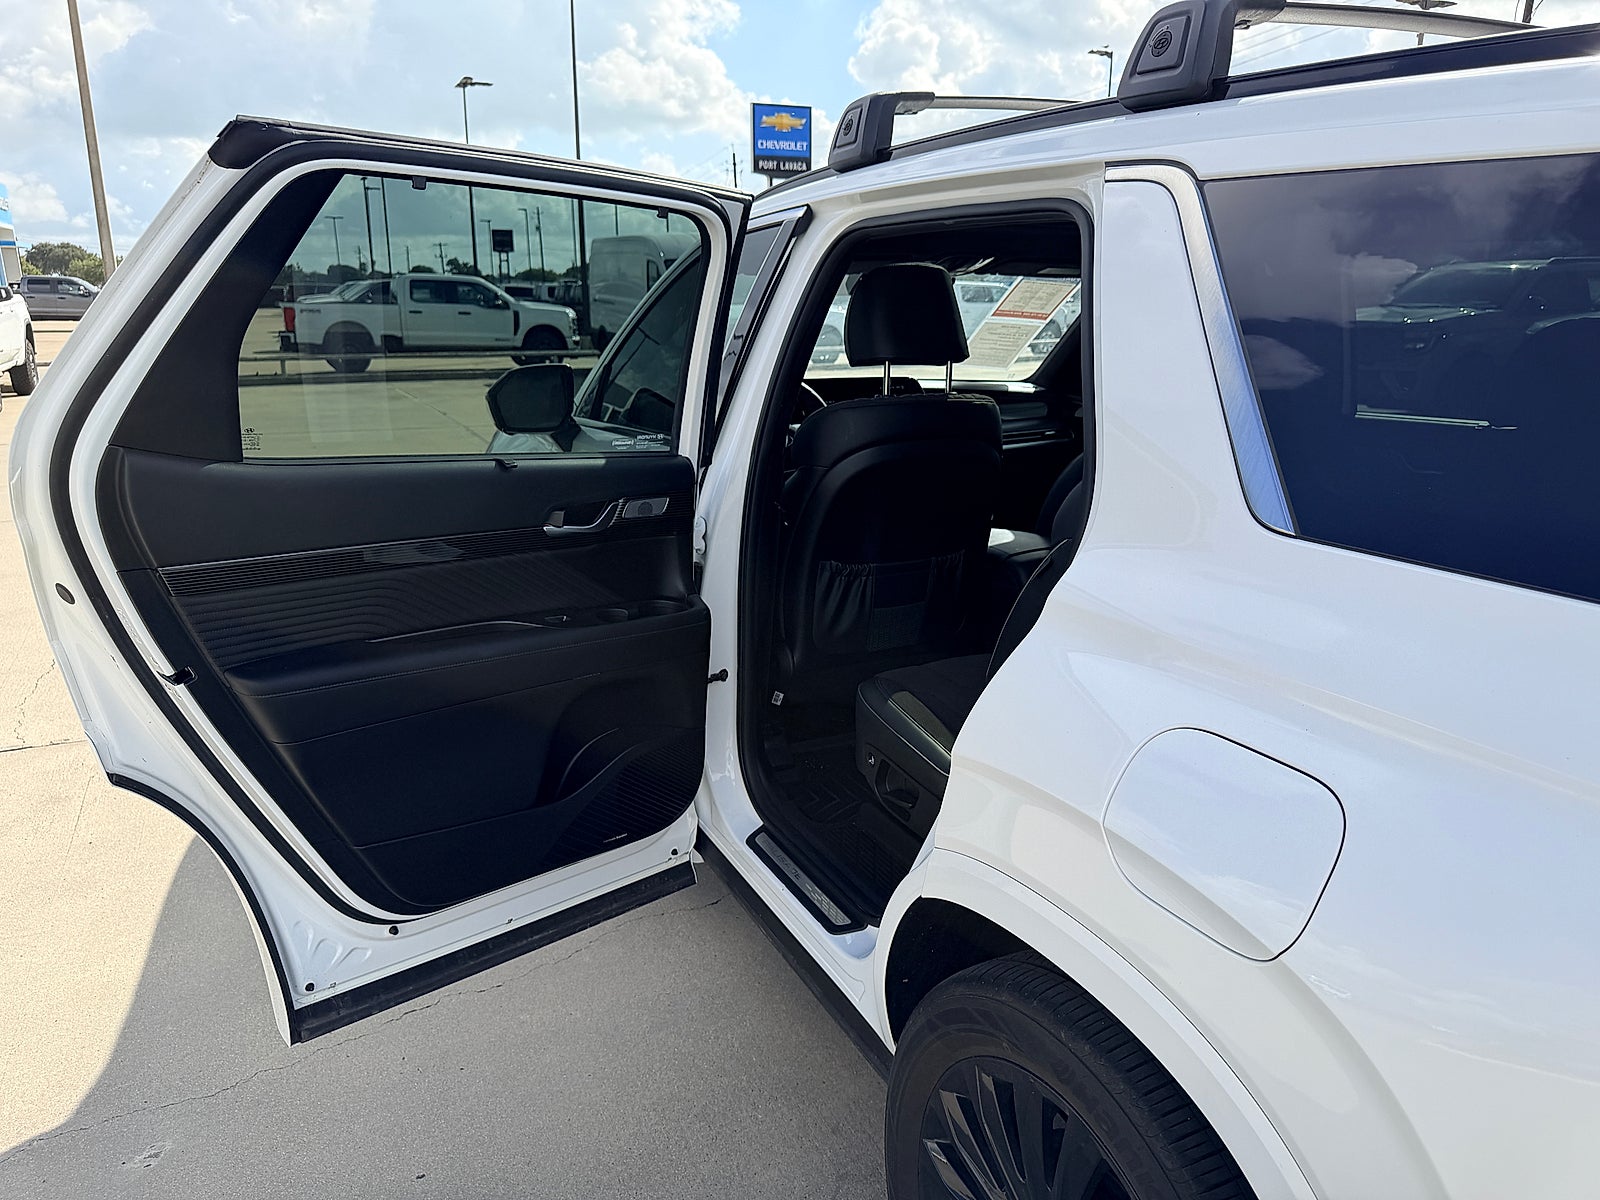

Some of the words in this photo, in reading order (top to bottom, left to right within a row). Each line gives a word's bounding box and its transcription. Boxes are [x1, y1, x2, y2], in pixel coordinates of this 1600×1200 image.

[757, 139, 808, 151] CHEVROLET
[758, 159, 778, 170] PORT
[780, 160, 808, 172] LAVACA
